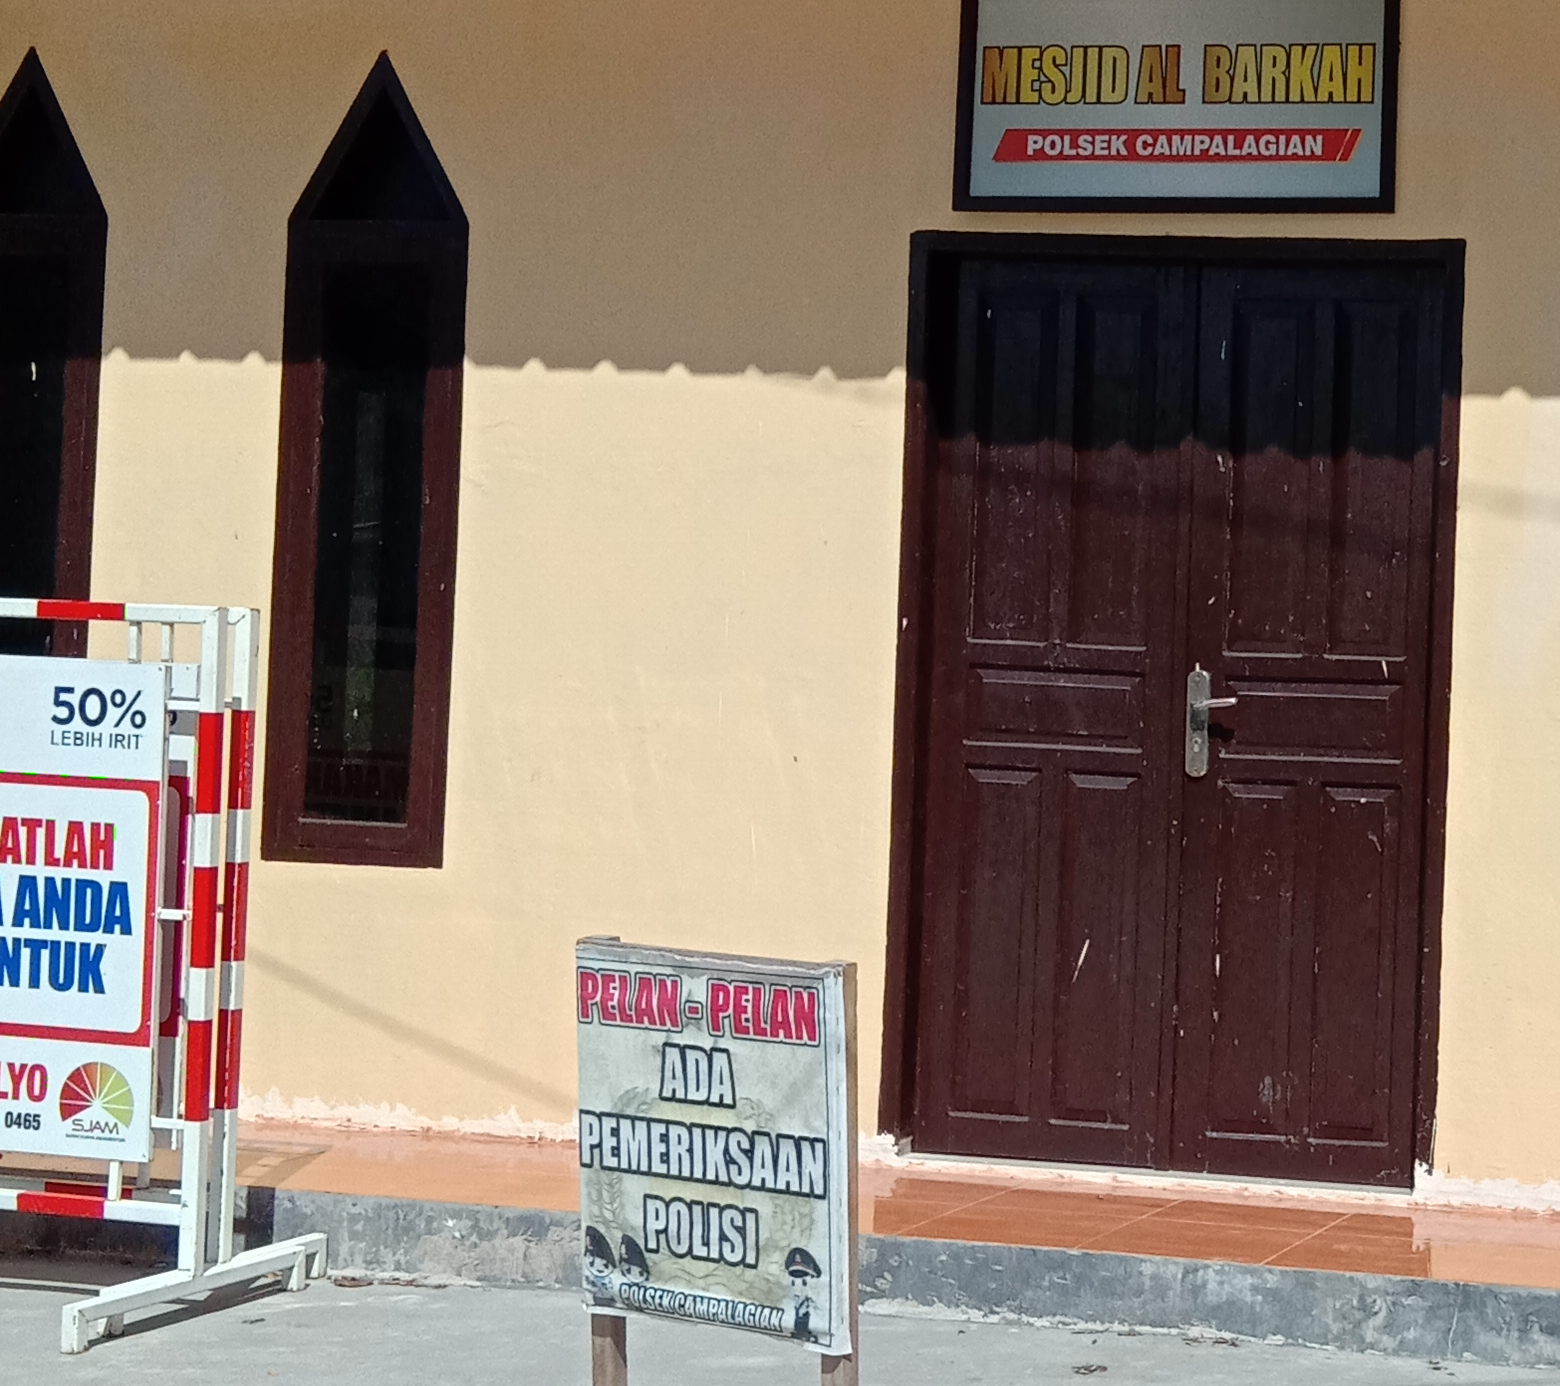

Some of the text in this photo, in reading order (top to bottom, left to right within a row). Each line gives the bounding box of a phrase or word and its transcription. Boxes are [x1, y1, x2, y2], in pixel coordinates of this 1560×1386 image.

[980, 43, 1376, 105] MESJID AL BARKAH
[1026, 134, 1323, 156] POLSEK CAMPALAGIAN
[51, 686, 147, 730] 50%
[50, 730, 143, 750] LEBIH IRIT
[0, 816, 115, 871] ATLAH
[11, 874, 133, 936] ANDA
[0, 935, 107, 995] NTUK
[577, 967, 683, 1032] PELAN
[706, 977, 820, 1046] PELAN
[659, 1042, 736, 1108] ADA
[4, 1111, 42, 1131] 0465
[71, 1118, 120, 1136] SJAM
[579, 1109, 828, 1199] PEMERIKSAAN
[643, 1193, 759, 1269] POLISI
[619, 1283, 785, 1333] POLSEK CAMPALAGIAN
